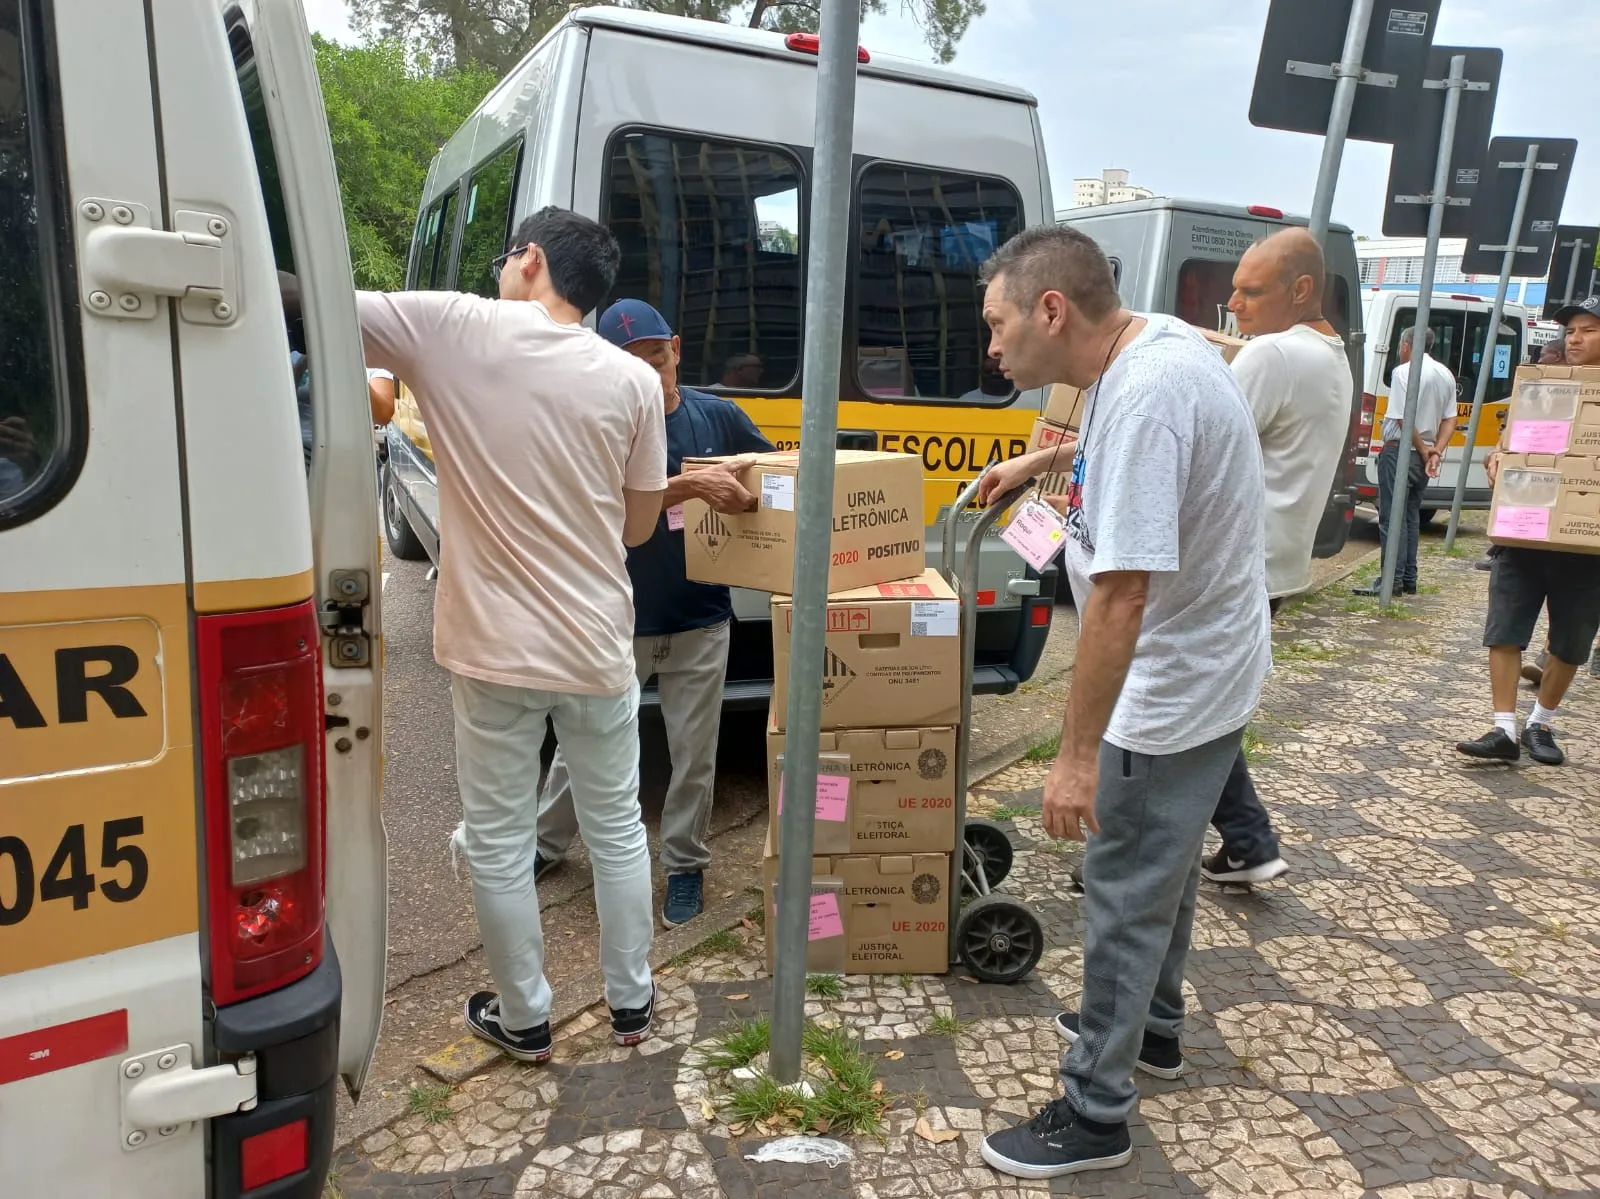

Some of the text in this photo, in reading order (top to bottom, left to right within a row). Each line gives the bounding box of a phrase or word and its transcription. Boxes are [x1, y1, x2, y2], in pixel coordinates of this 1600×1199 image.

[1192, 234, 1210, 244] EMTU
[1499, 360, 1506, 373] 9
[847, 489, 886, 508] URNA
[832, 507, 909, 533] LETRÔNICA
[832, 539, 920, 566] 2020 POSITIVO
[898, 797, 952, 809] UE 2020
[857, 831, 911, 840] ELEITORAL
[0, 816, 149, 926] 045
[892, 921, 945, 932] UE 2020
[858, 942, 898, 953] JUSTIÇA
[852, 952, 904, 961] ELEITORAL
[29, 1048, 50, 1060] 3M
